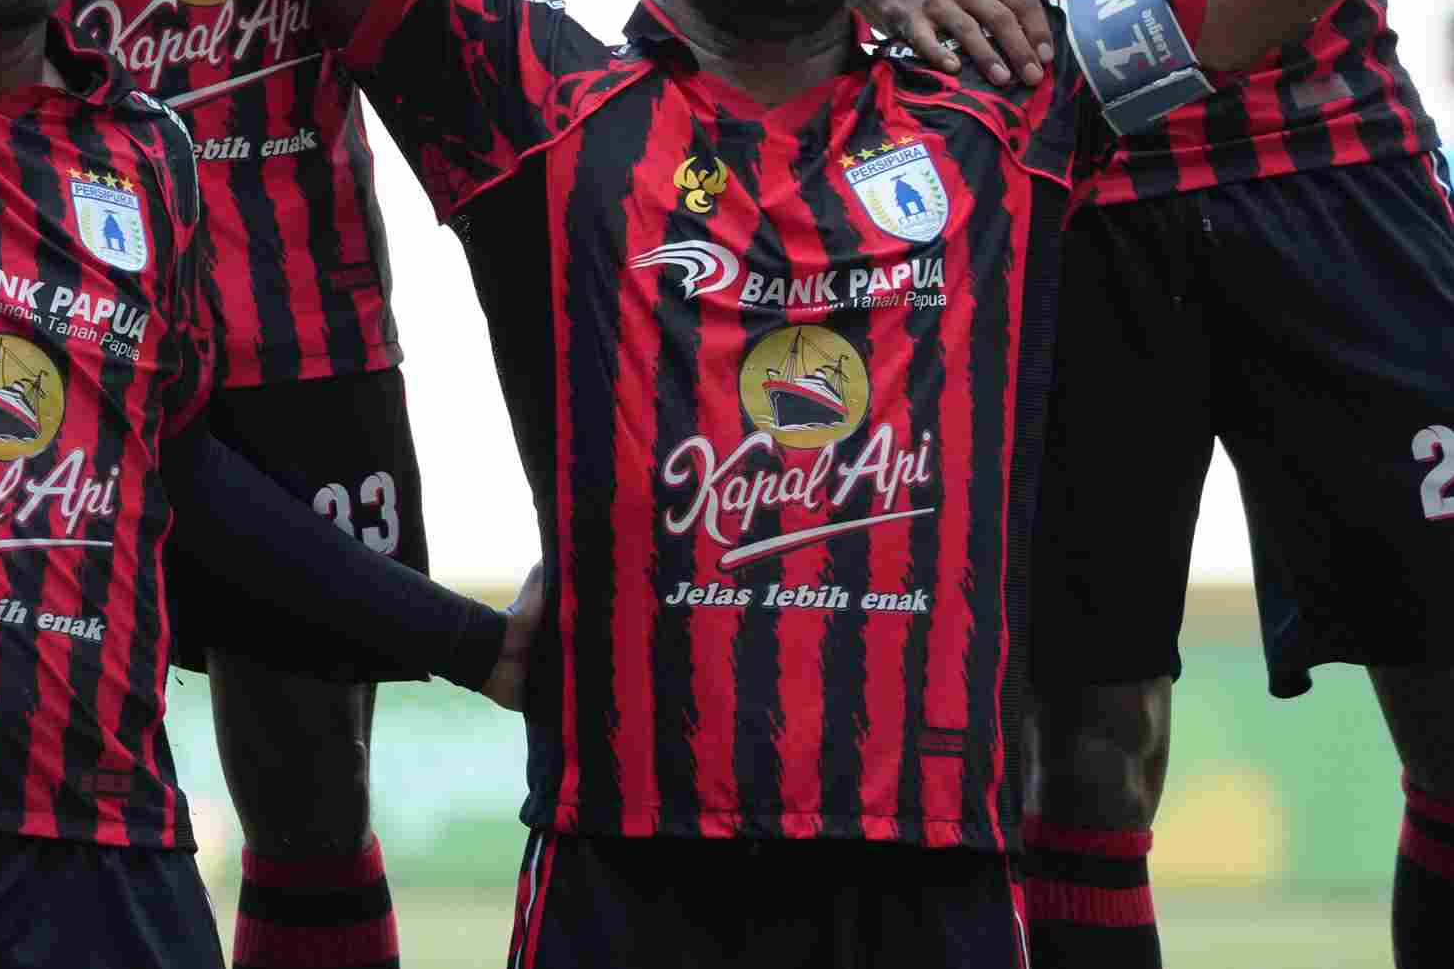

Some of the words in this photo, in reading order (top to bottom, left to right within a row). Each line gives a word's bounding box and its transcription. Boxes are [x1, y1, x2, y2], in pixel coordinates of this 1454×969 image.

[192, 130, 250, 160] ebih
[261, 129, 318, 157] enak
[850, 148, 923, 181] PERSIPURA
[740, 270, 839, 306] BANK
[849, 257, 946, 298] PAPUA
[903, 290, 947, 310] Papua
[49, 285, 150, 344] PAPUA
[46, 315, 98, 342] Tanah
[98, 333, 140, 361] Papua
[17, 446, 120, 535] Api
[664, 431, 834, 546] Kapal
[831, 423, 932, 509] Api
[665, 581, 753, 607] Jelas
[762, 583, 849, 609] lebih
[860, 588, 928, 612] enak
[36, 612, 107, 641] enak
